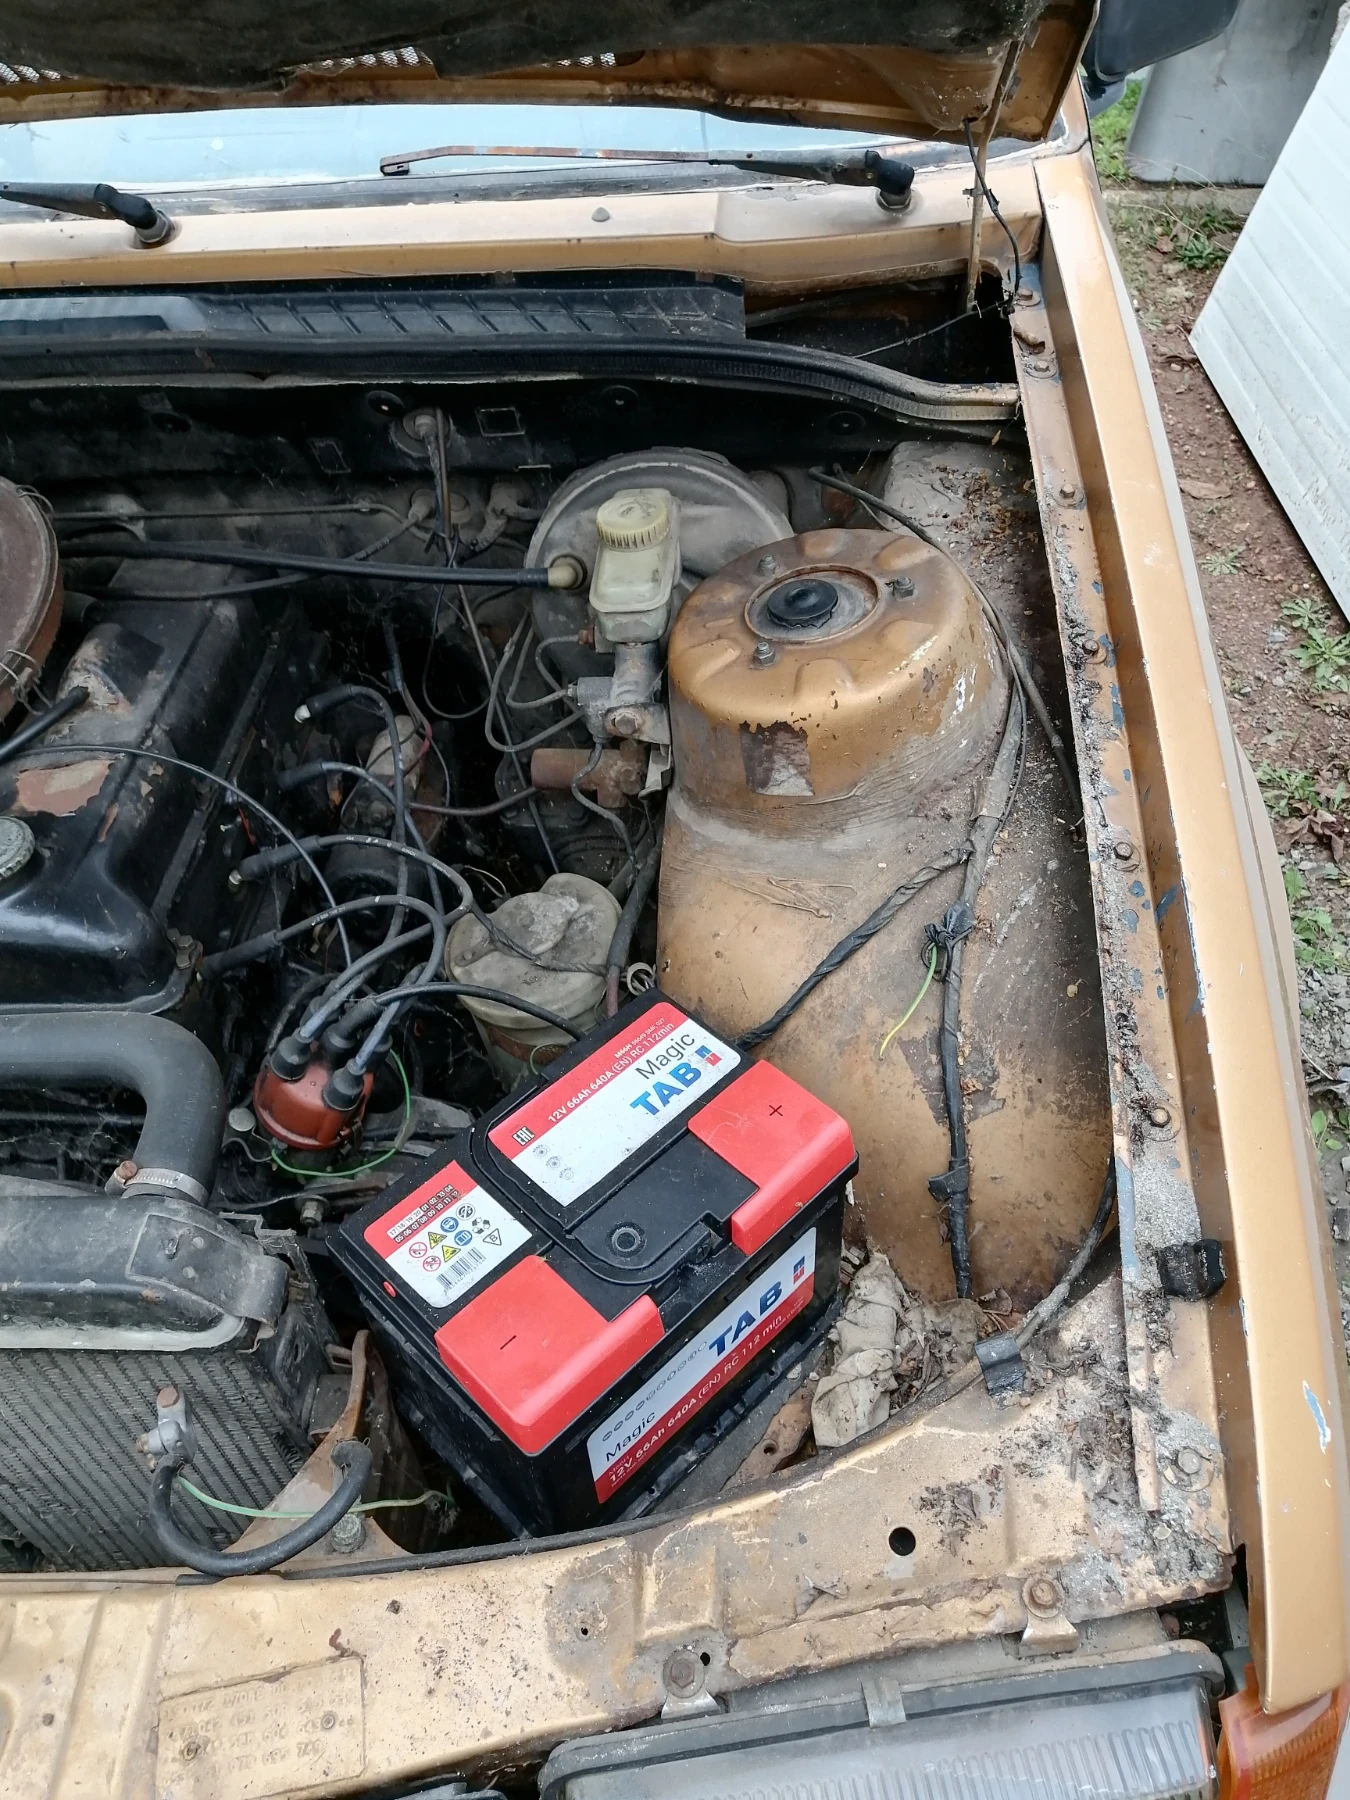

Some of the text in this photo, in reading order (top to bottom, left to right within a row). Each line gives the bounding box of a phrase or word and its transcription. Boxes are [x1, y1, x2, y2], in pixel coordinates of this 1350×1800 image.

[548, 1106, 568, 1123] 12V
[566, 1088, 592, 1109] 66Ah
[589, 1070, 615, 1091] 640A
[612, 1057, 633, 1073] (EN)
[630, 1045, 645, 1058] RC
[629, 1062, 702, 1116] TAB
[635, 1034, 695, 1080] Magic
[709, 1281, 783, 1357] TAB
[609, 1457, 633, 1482] 12V
[635, 1427, 666, 1459] 66Ah
[667, 1398, 697, 1428] 640A
[698, 1373, 721, 1399] (EN)
[724, 1356, 739, 1374] RC
[741, 1335, 760, 1356] 112
[762, 1315, 782, 1336] min
[605, 1412, 655, 1462] Magic
